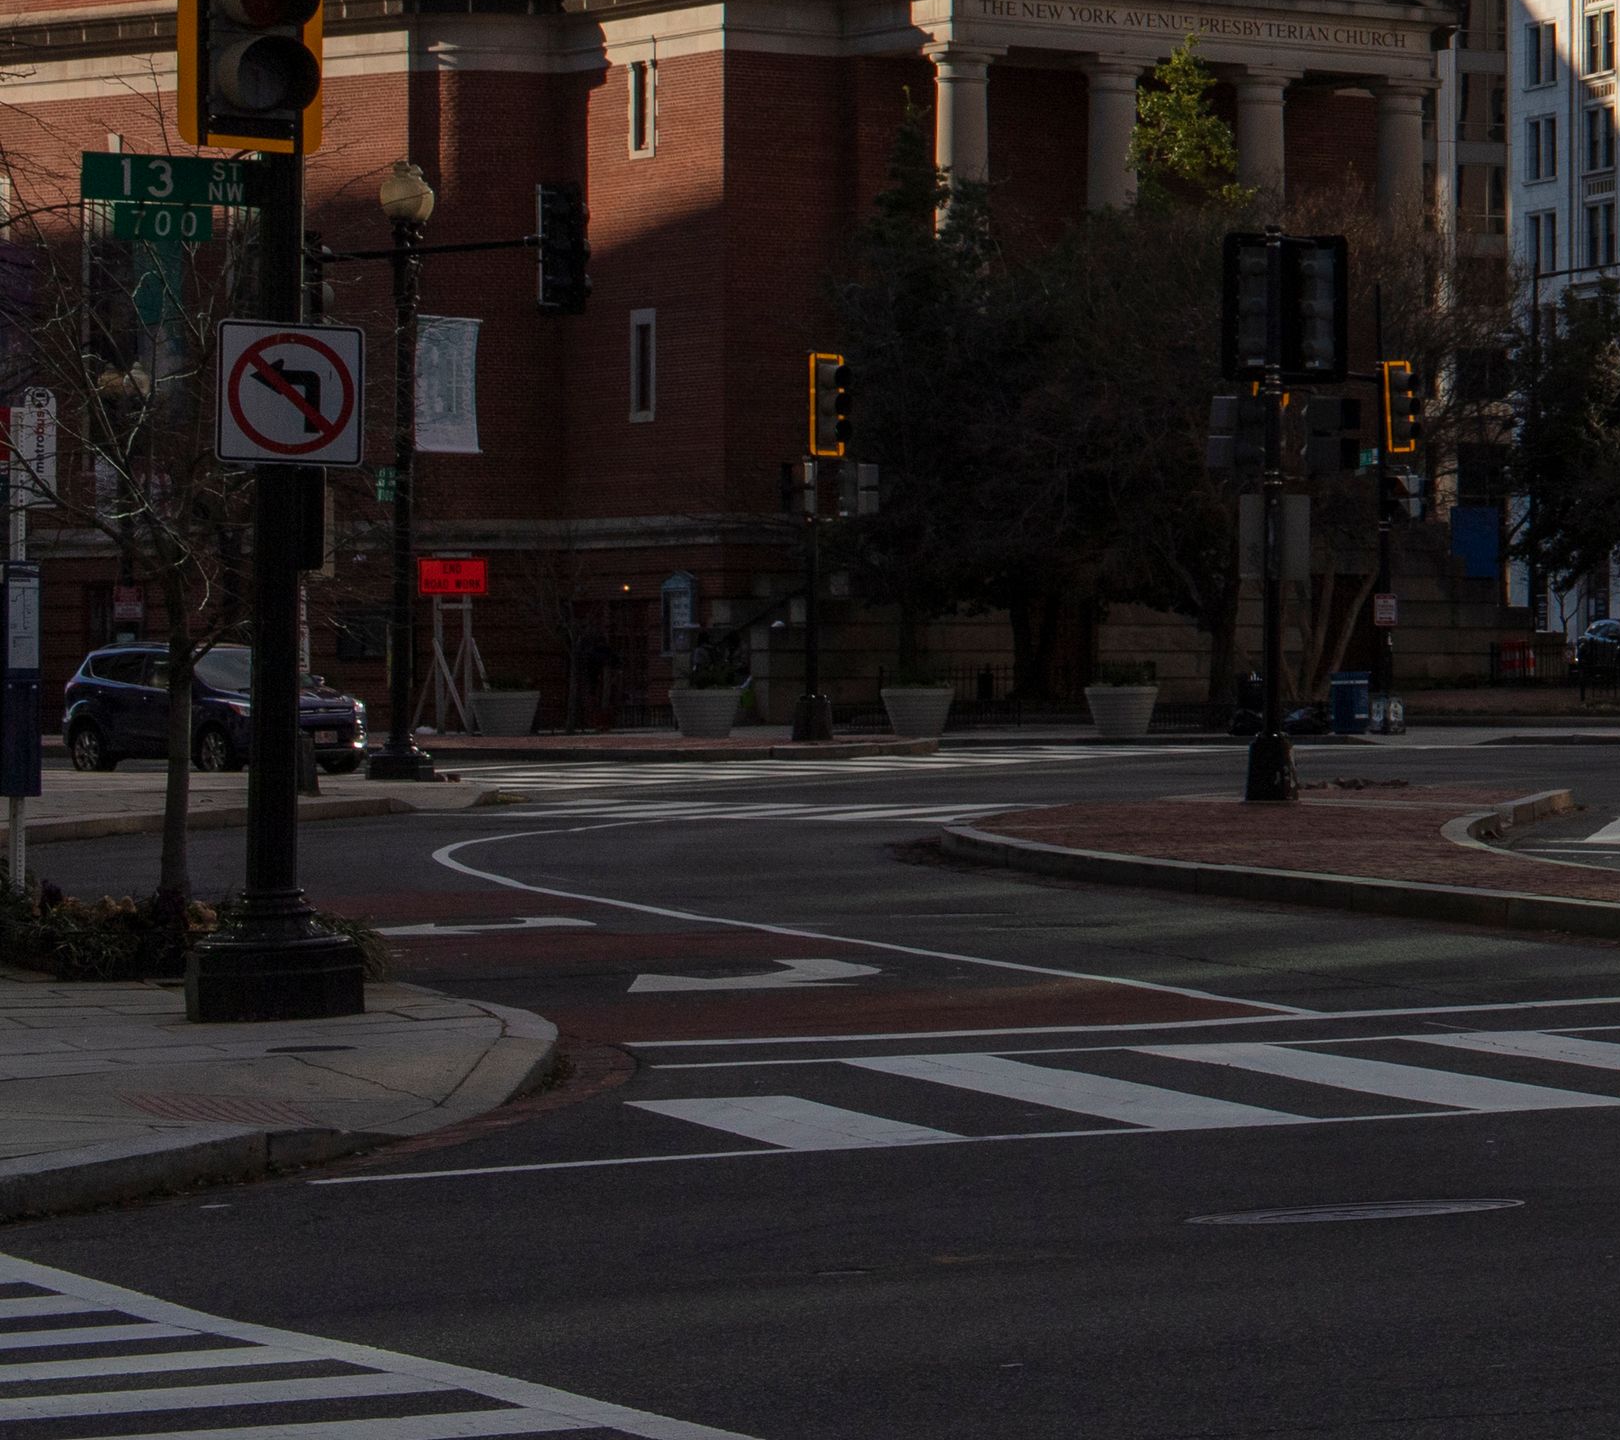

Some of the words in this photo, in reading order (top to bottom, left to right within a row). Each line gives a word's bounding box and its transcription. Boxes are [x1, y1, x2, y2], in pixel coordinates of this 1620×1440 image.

[979, 0, 1016, 17] THE
[1022, 3, 1064, 20] NEW
[1068, 6, 1118, 24] YORK
[1200, 17, 1330, 42] PRESBYTERIAN
[1334, 28, 1406, 48] CHURCH
[121, 158, 174, 198] 13
[212, 161, 241, 181] ST
[208, 182, 244, 202] NW
[130, 210, 198, 237] 700
